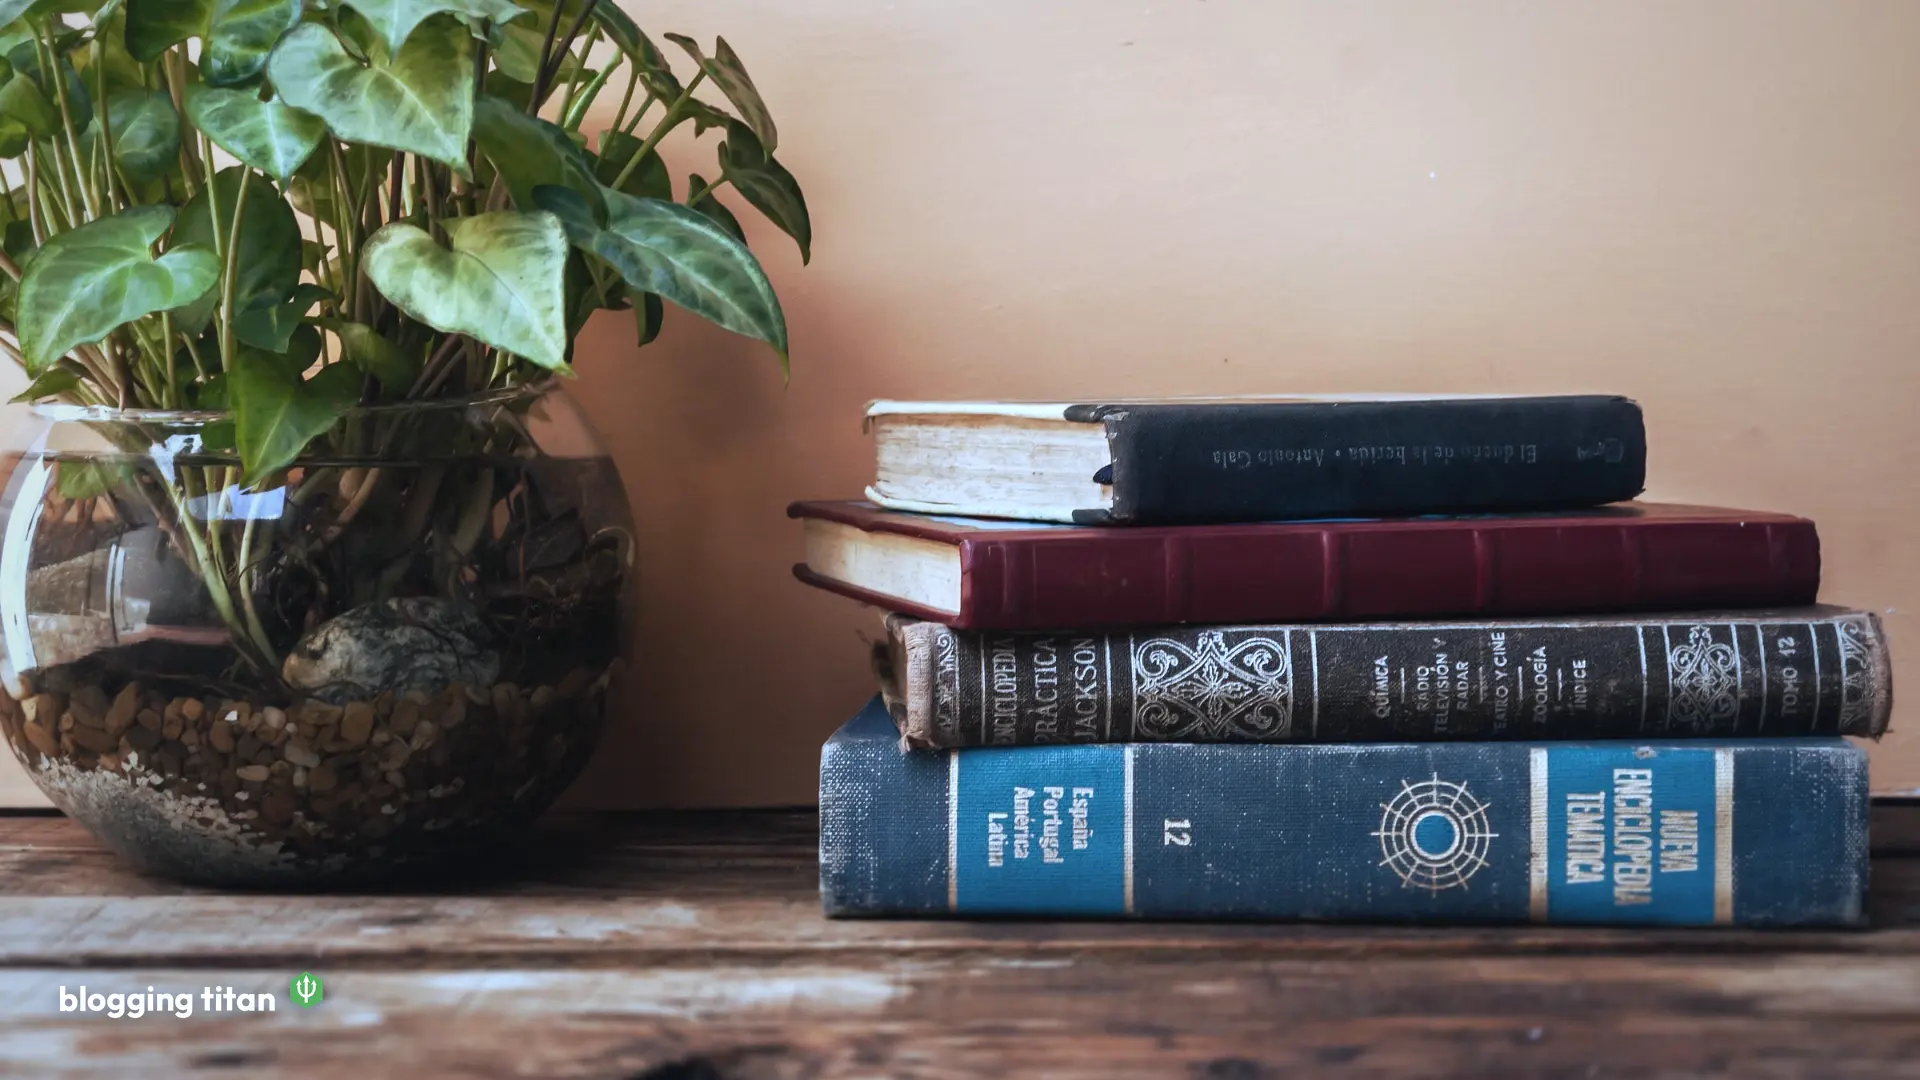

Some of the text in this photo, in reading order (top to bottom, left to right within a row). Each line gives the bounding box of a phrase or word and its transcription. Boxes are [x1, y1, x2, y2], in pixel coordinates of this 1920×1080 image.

[1213, 450, 1250, 469] Gala
[1258, 449, 1324, 467] Antonio
[1349, 446, 1406, 465] herida
[1435, 446, 1454, 464] de
[1520, 444, 1537, 463] El
[992, 638, 1017, 744] ENCICLOPEDIA
[1073, 638, 1098, 740] JACKSON
[1370, 655, 1390, 718] QUÍMICA
[1417, 665, 1430, 710] RADIO
[1430, 653, 1449, 732] TELEVISIÓN
[1455, 661, 1469, 710] RADAR
[1492, 631, 1509, 731] EATRO Y CINE
[1526, 646, 1548, 723] ZOOLOGÍA
[1777, 636, 1799, 716] TOMO 12
[988, 812, 1009, 867] Latina
[1013, 786, 1036, 858] América
[1039, 786, 1064, 864] Portugal
[1068, 787, 1094, 850] España
[1164, 818, 1191, 846] 12
[1566, 791, 1606, 884] TEMATICA
[1613, 768, 1653, 906] ENCICLOPEDIA
[1659, 810, 1698, 873] NUEVA
